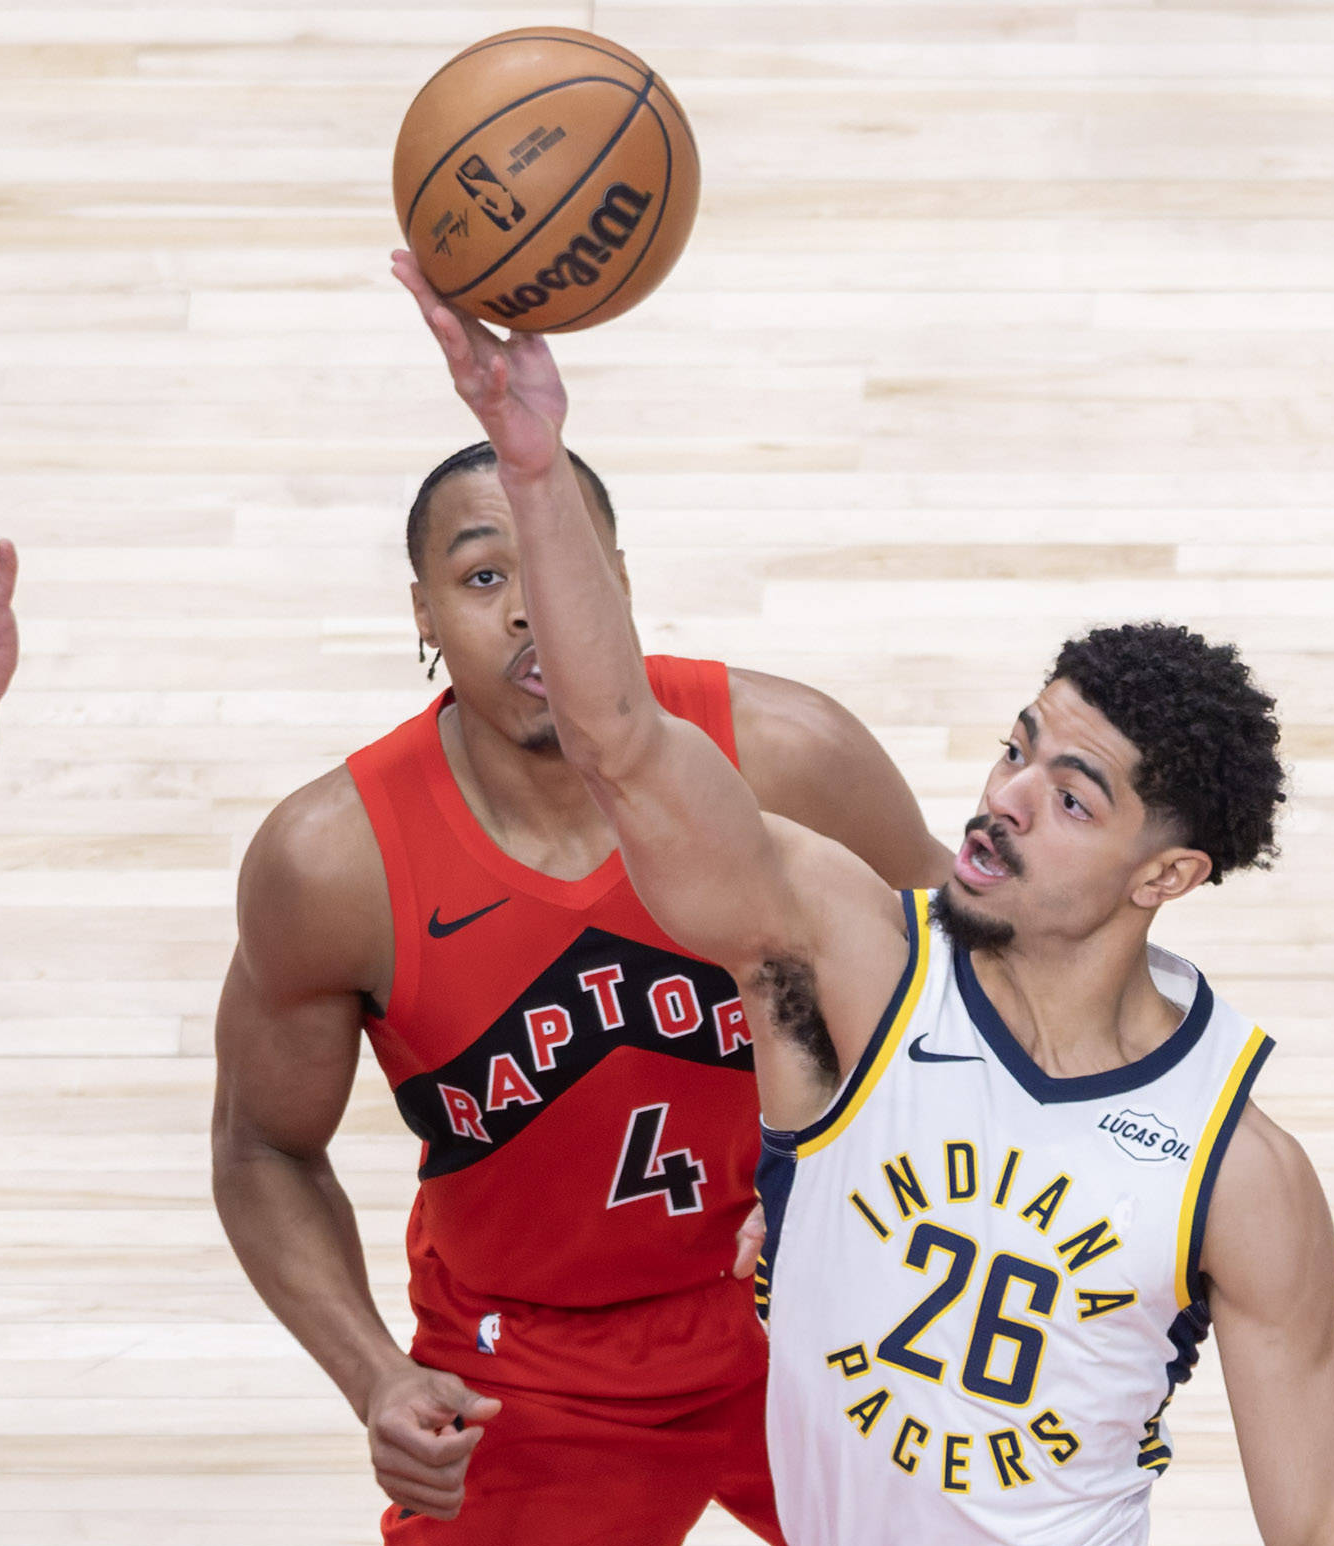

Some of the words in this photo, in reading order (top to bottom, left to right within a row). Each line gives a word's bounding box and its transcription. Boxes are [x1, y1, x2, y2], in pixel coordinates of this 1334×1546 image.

[483, 182, 654, 319] Wilson
[606, 1102, 708, 1217] 4
[1097, 1113, 1161, 1148] LUCAS
[1161, 1138, 1191, 1161] OIL
[848, 1140, 1138, 1322] INDIANA
[873, 1221, 1063, 1408] 26
[826, 1343, 1082, 1494] PACERS
